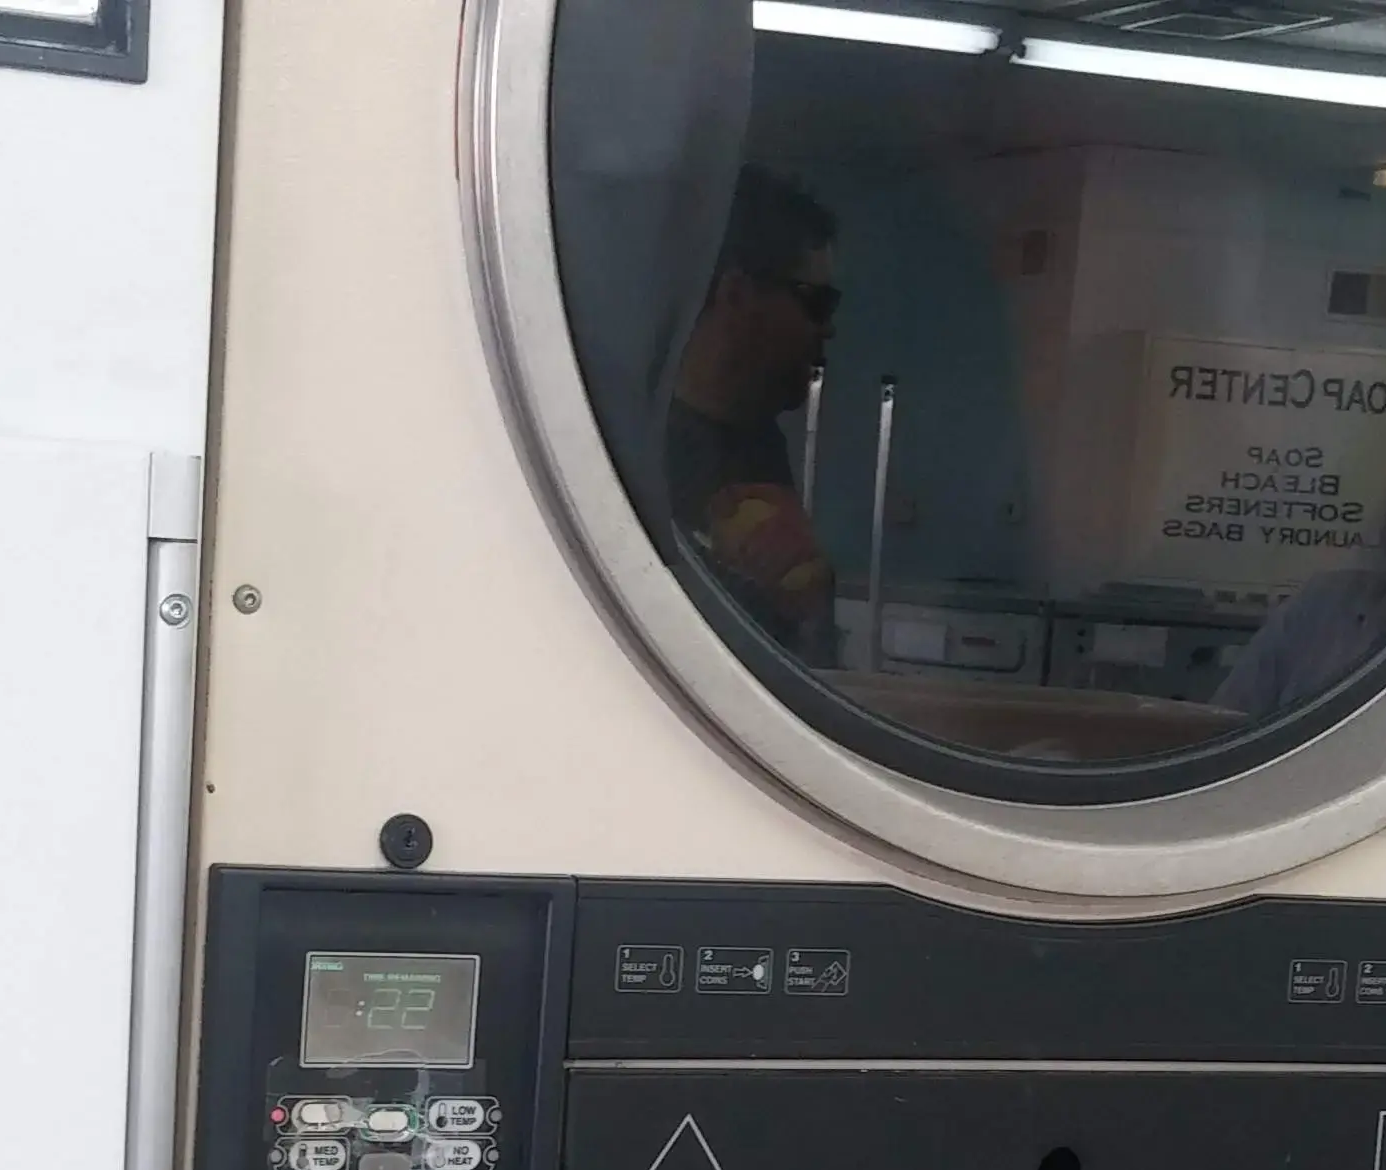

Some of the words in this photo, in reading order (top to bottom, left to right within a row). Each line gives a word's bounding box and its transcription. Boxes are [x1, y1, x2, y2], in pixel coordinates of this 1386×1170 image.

[622, 949, 630, 958] 1
[704, 950, 713, 960] 2
[791, 952, 800, 962] 3
[621, 963, 657, 972] SELECT
[700, 965, 732, 973] INSERT
[788, 966, 813, 975] PUSH
[1364, 964, 1373, 973] 2
[621, 974, 646, 983] TEMP
[451, 1106, 477, 1115] LOW
[450, 1117, 478, 1126] TEMP
[314, 1146, 339, 1155] MED
[453, 1146, 470, 1155] NO
[313, 1158, 340, 1167] TEMP
[447, 1157, 473, 1166] HEAT
